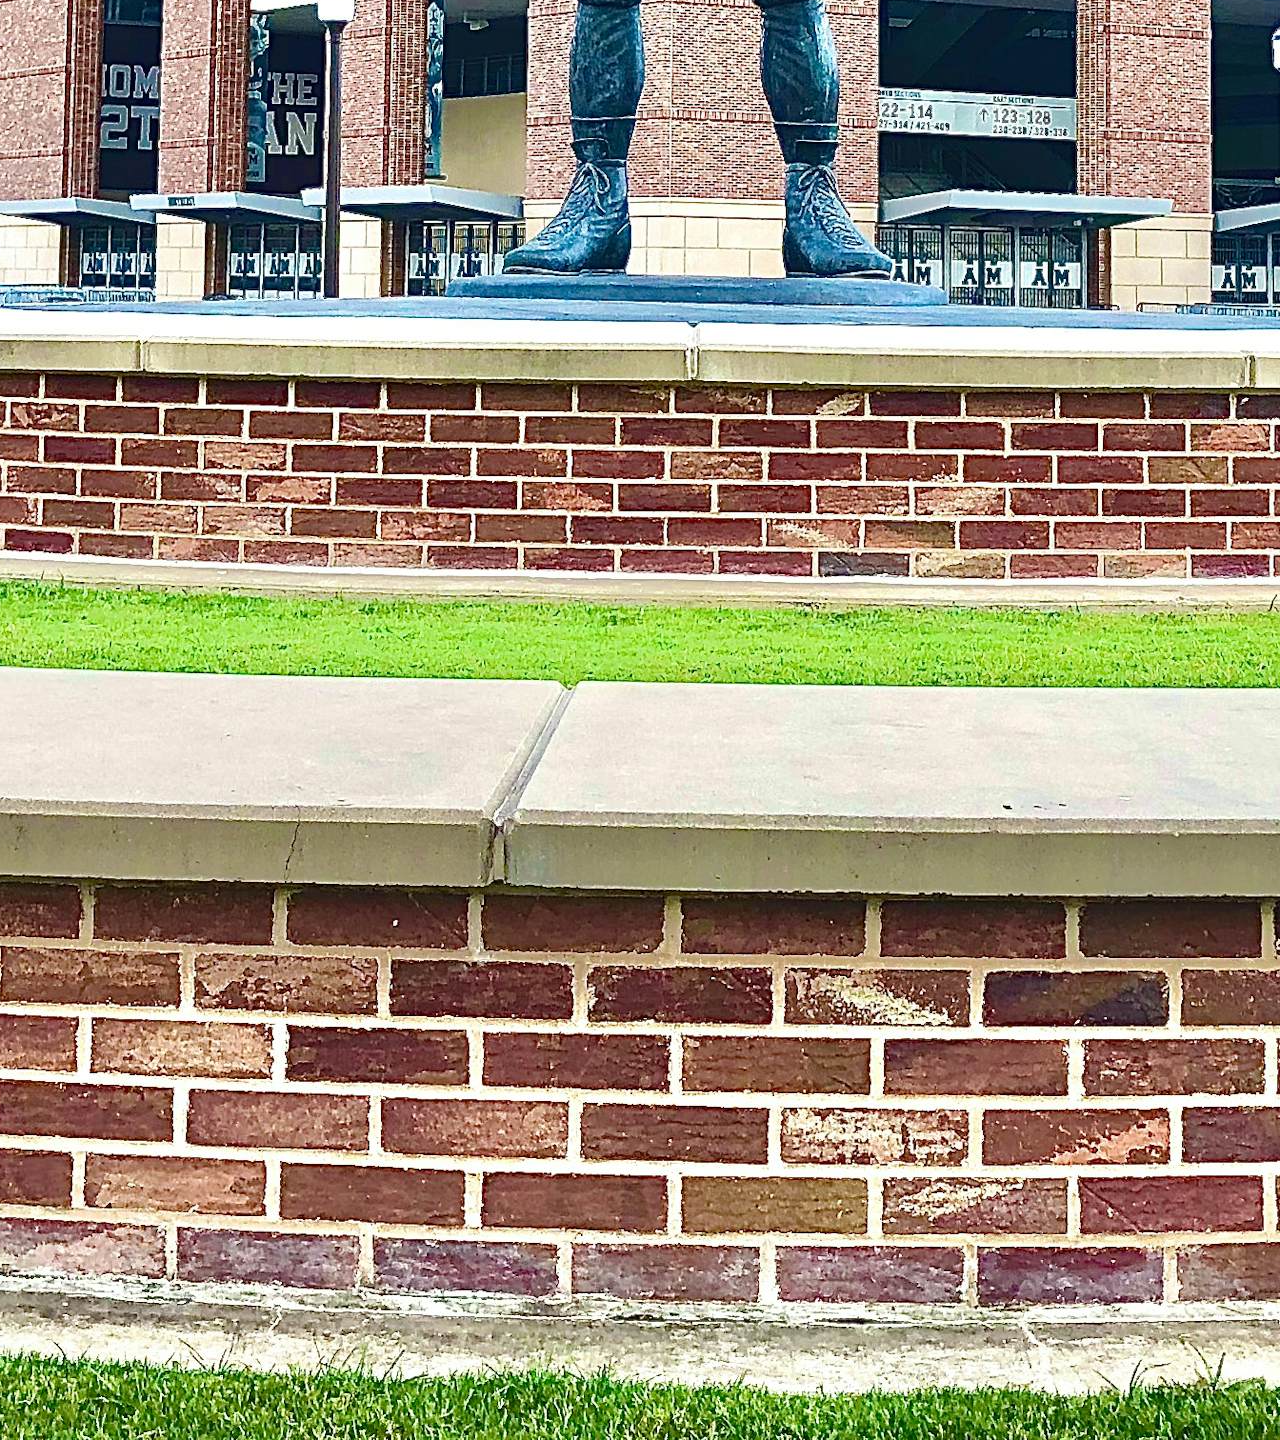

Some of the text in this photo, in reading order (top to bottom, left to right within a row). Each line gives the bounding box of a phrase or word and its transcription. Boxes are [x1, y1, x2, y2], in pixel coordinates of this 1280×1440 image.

[267, 72, 318, 105] HE
[878, 102, 933, 120] 22-114
[993, 107, 1051, 126] 123-128
